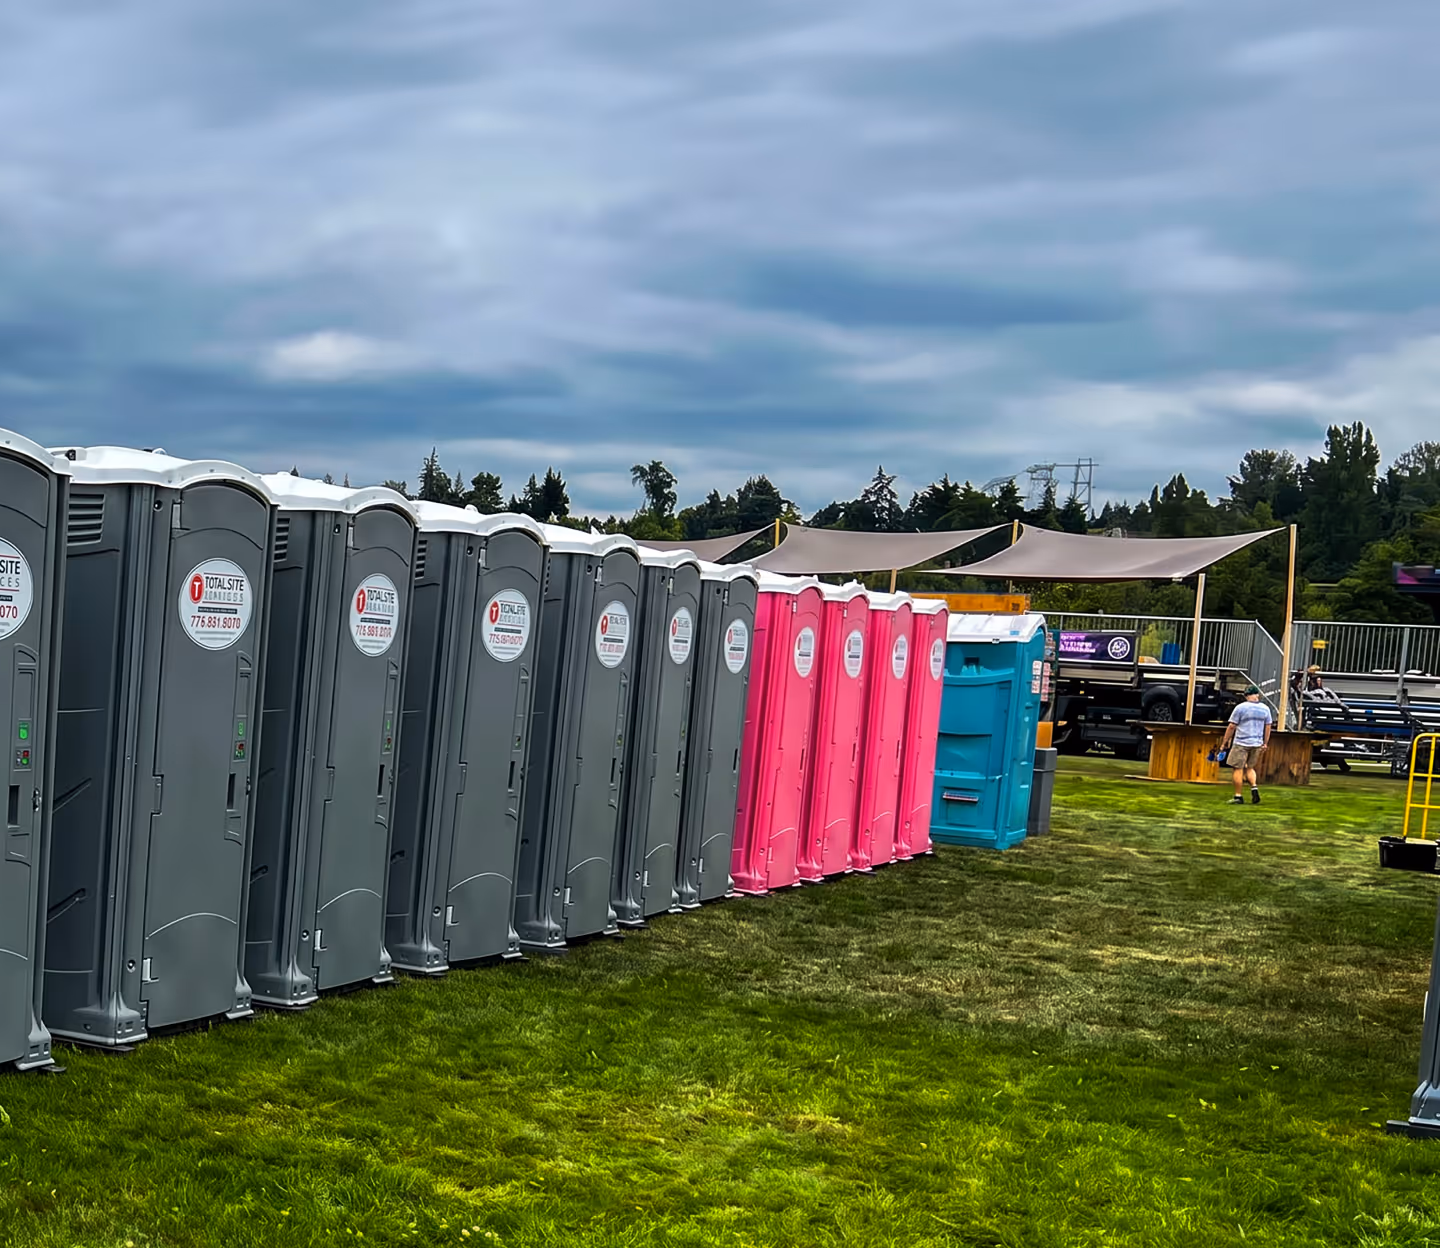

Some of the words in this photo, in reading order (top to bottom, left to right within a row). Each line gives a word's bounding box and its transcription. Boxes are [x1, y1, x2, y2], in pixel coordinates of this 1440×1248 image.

[0, 560, 21, 575] SITE
[205, 576, 226, 590] TOTAL
[227, 578, 244, 591] SITE
